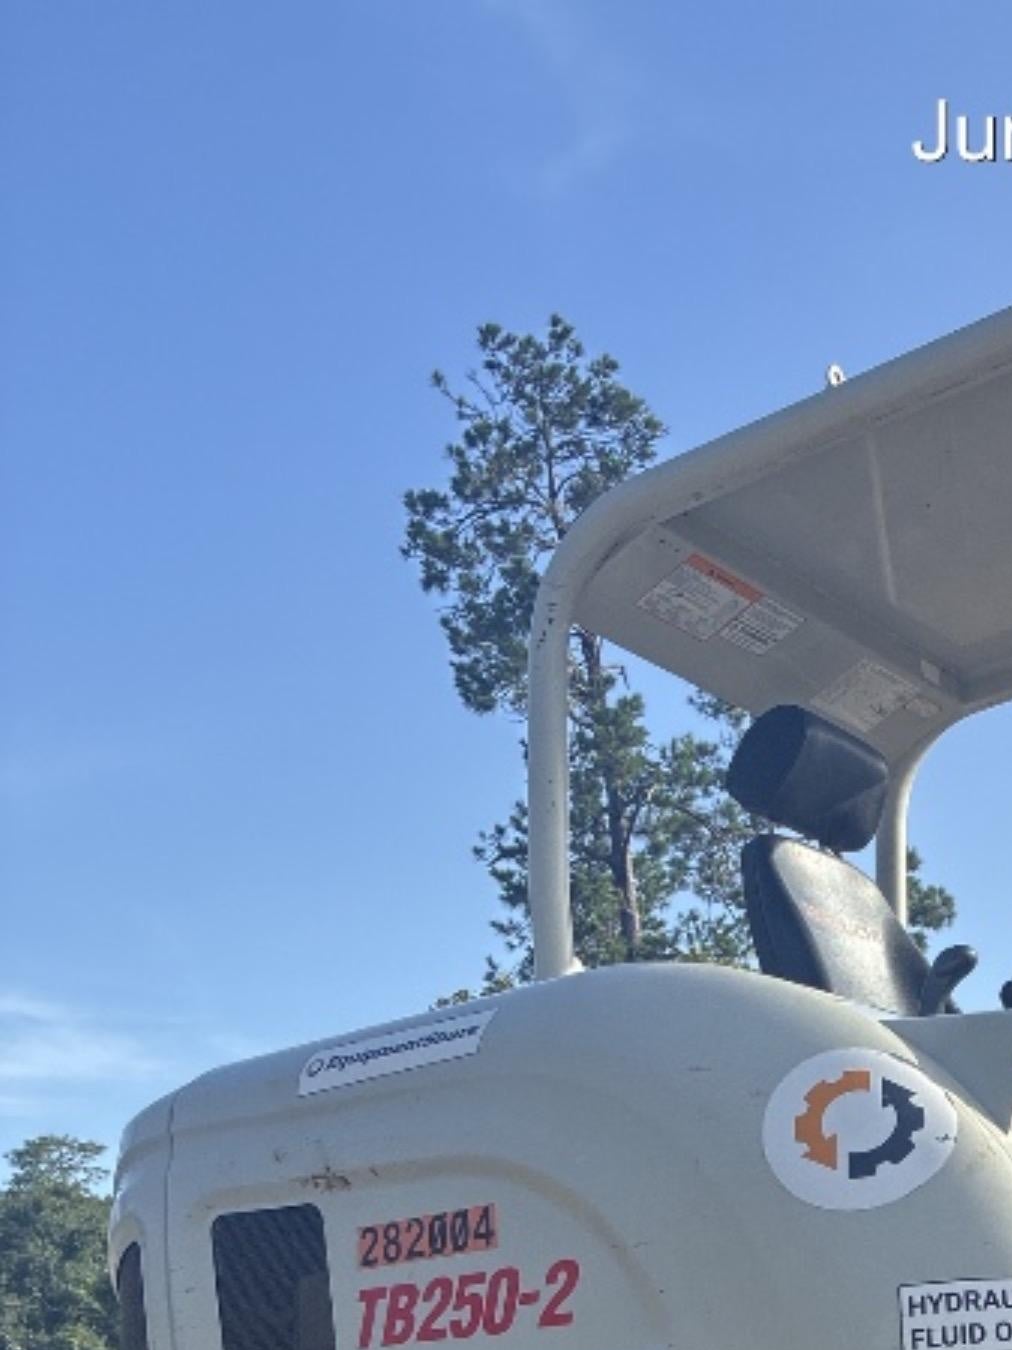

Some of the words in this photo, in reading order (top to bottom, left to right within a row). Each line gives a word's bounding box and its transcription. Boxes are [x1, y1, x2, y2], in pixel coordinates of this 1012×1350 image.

[358, 1205, 496, 1268] 282004
[358, 1258, 581, 1350] TB250-2
[910, 1322, 986, 1350] FLUID
